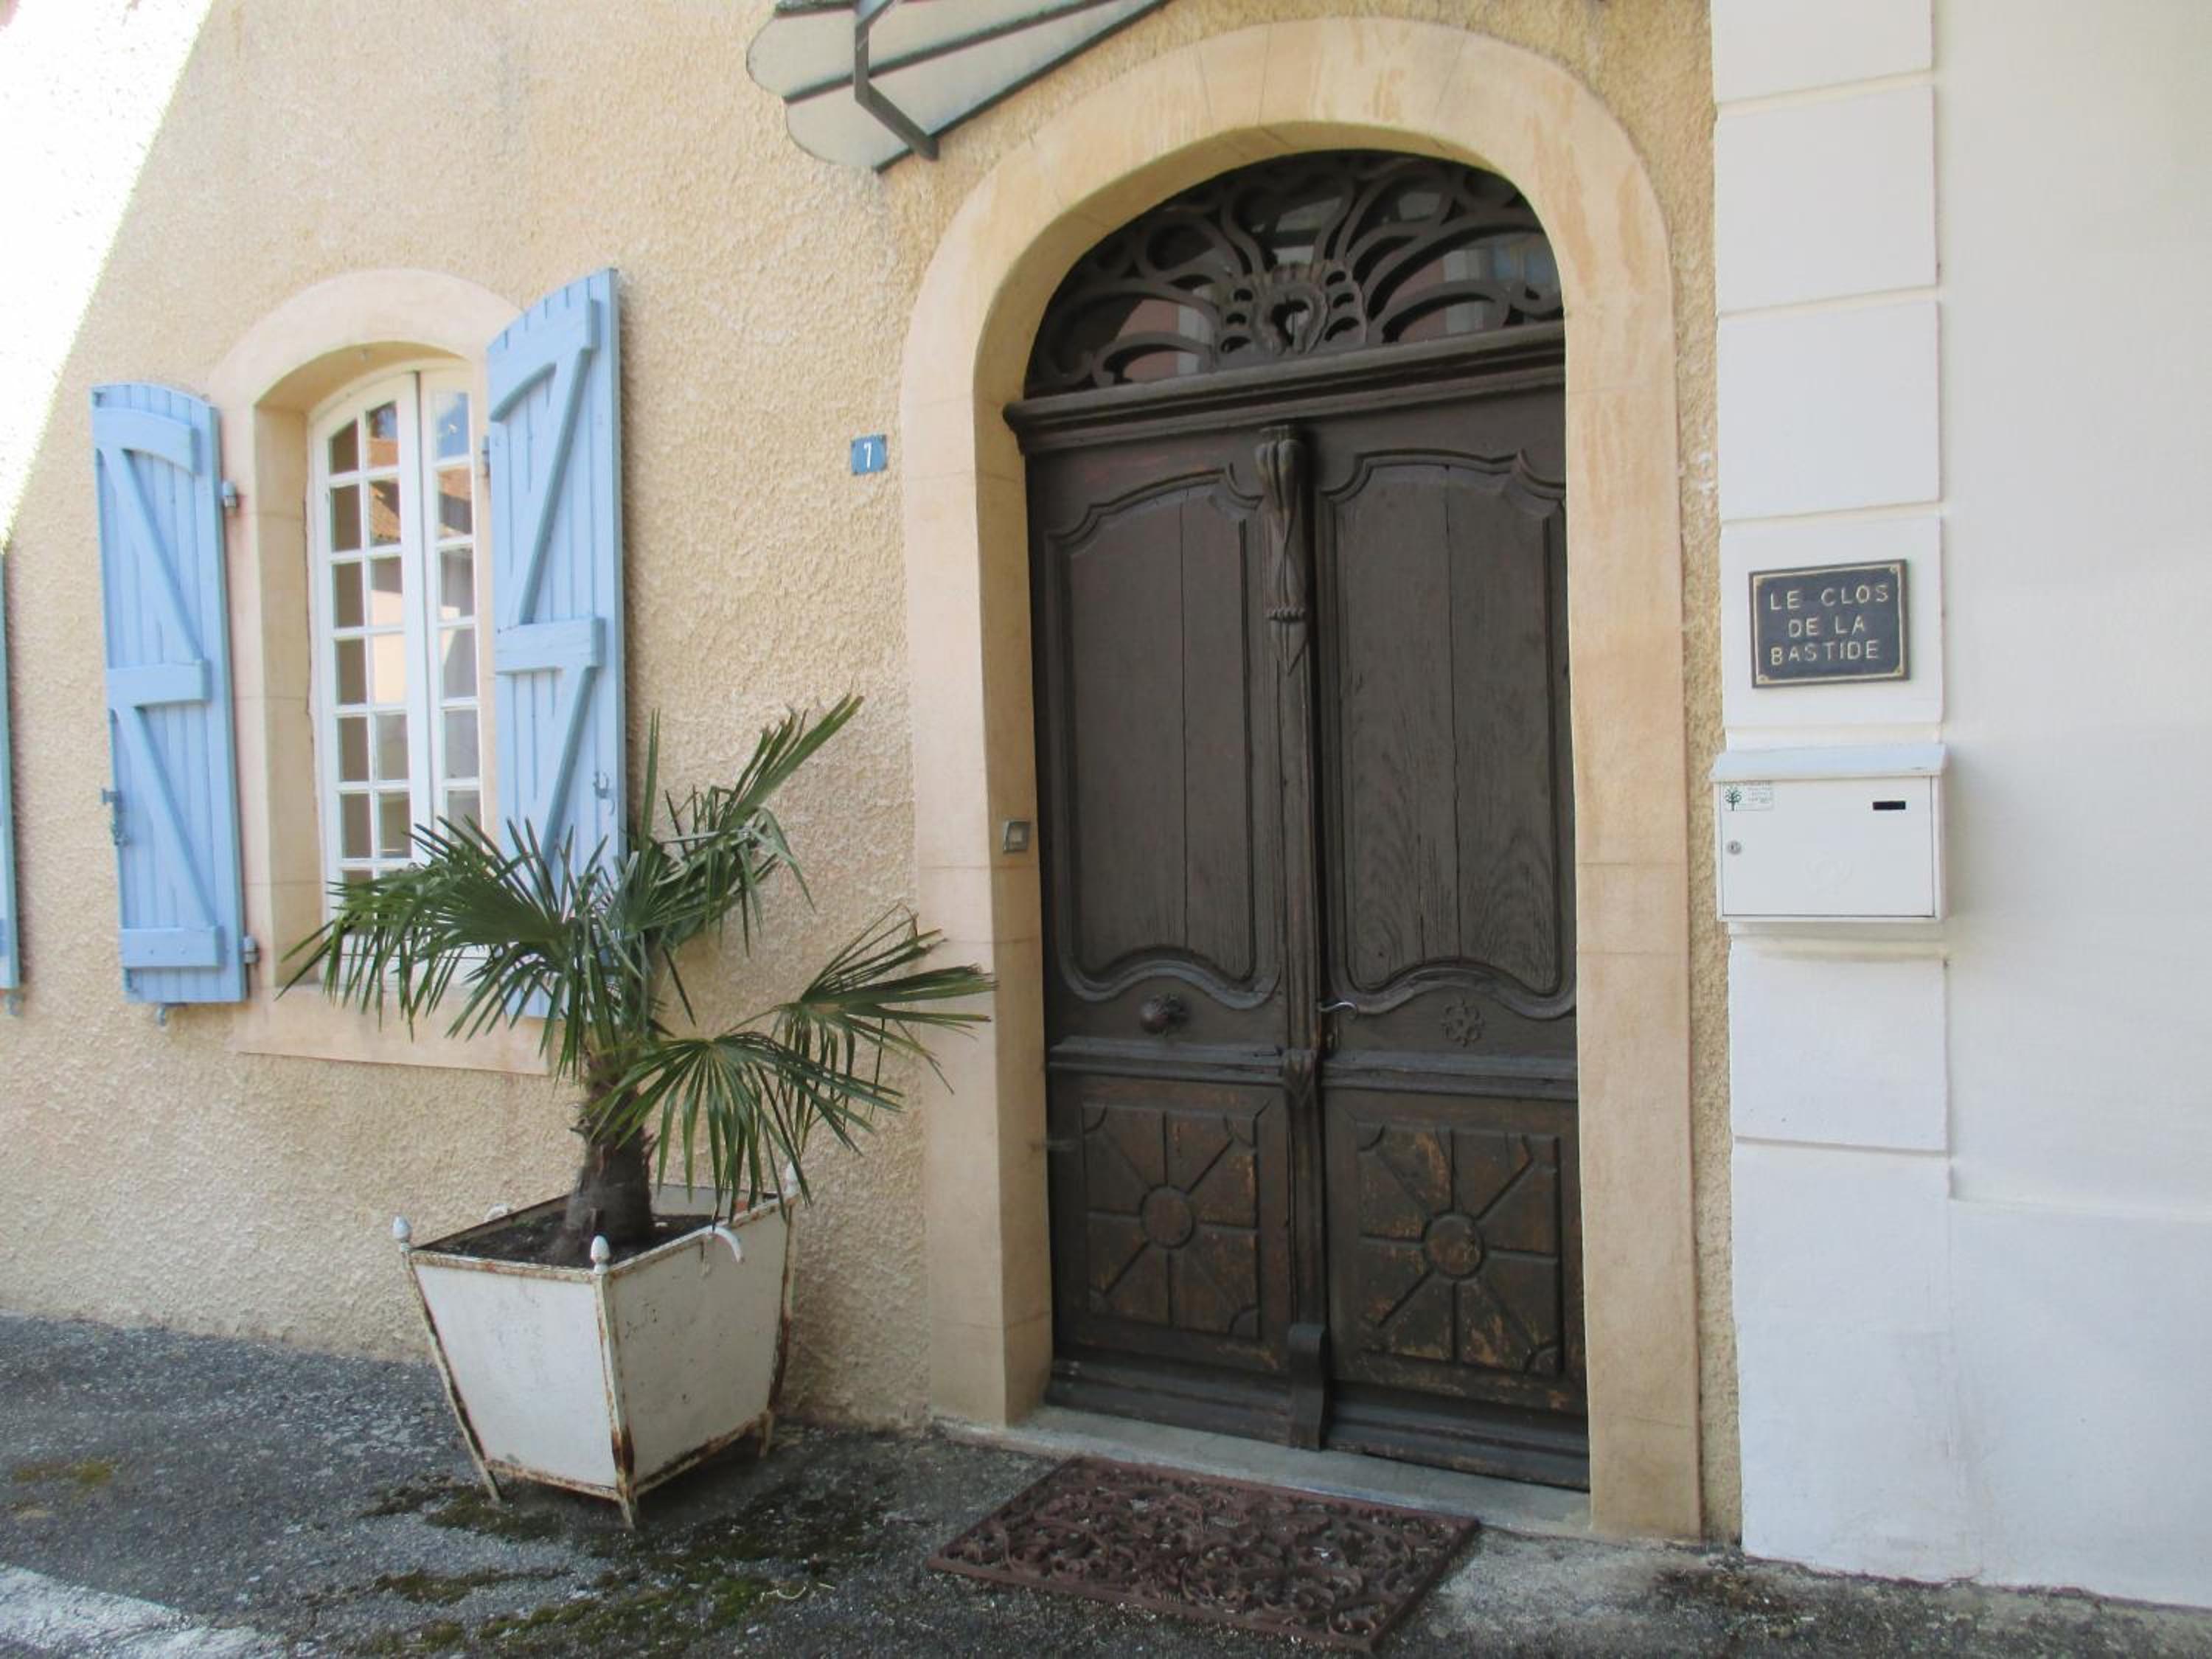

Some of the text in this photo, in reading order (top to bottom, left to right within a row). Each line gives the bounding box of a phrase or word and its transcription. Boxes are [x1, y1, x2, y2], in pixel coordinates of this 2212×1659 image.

[863, 442, 872, 469] 7
[1770, 584, 1888, 611] LE CLOS
[1788, 615, 1865, 638] DE LA
[1770, 639, 1879, 666] BASTIDE
